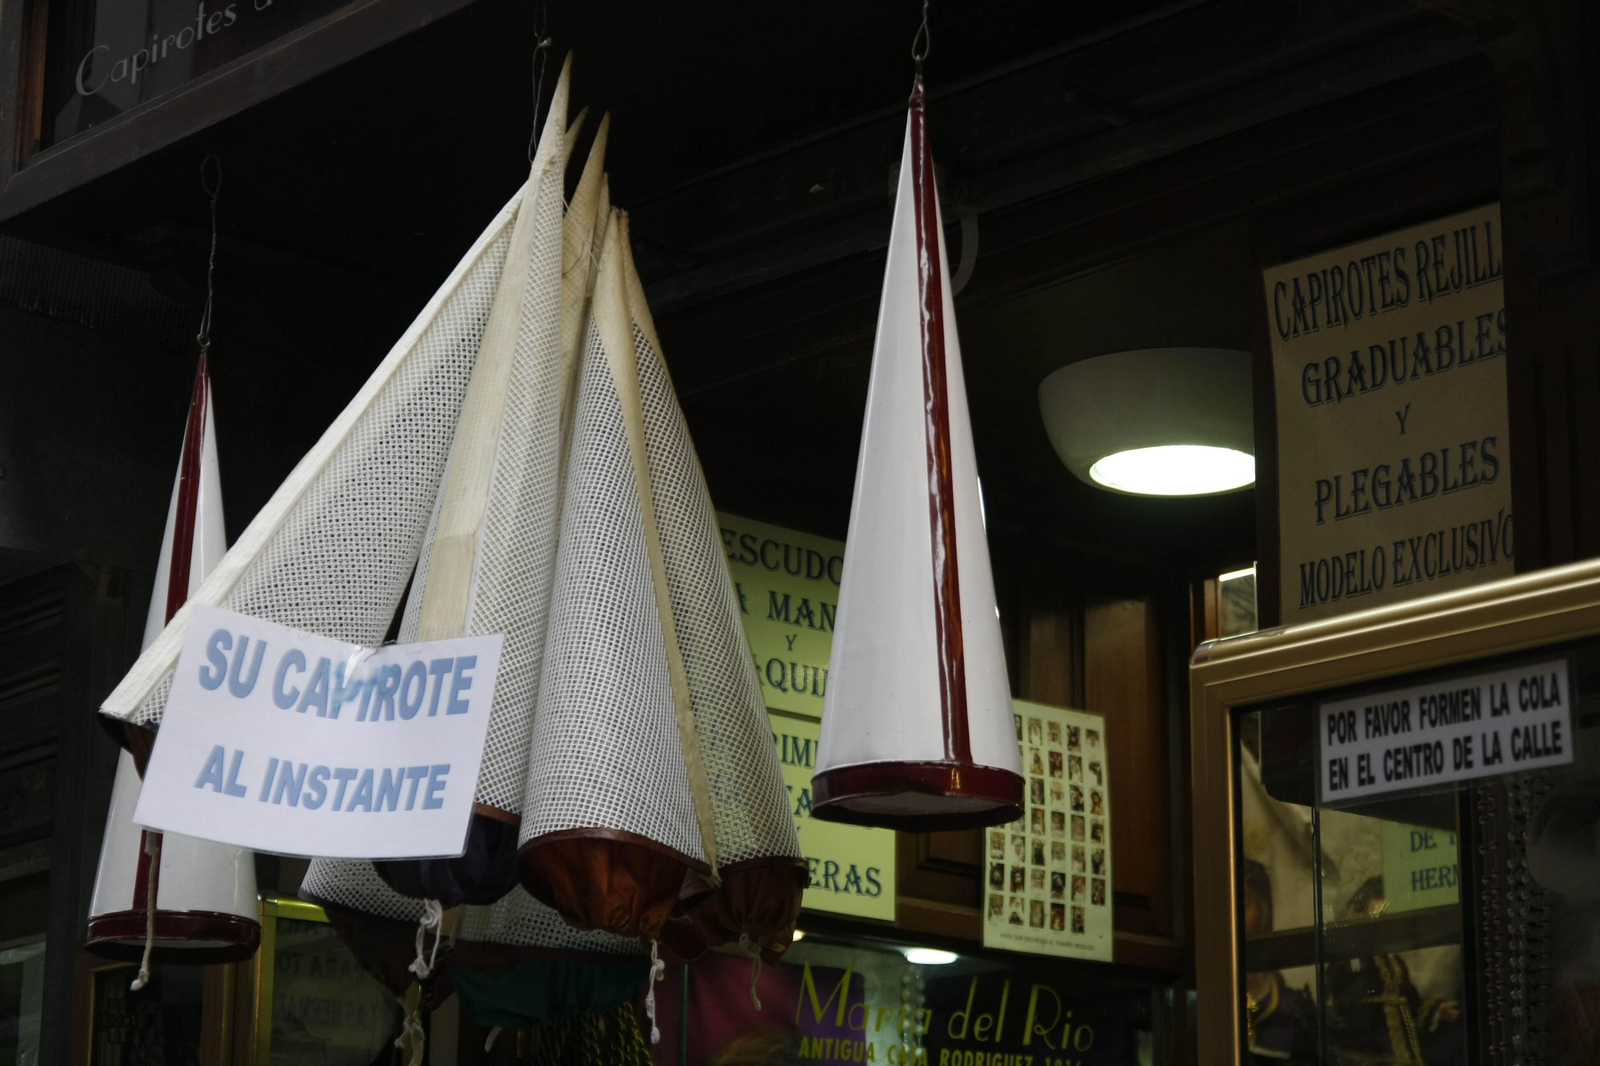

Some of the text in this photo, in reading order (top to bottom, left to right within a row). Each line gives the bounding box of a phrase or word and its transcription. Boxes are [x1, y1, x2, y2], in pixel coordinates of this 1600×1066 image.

[75, 3, 237, 96] Capirotes
[1274, 247, 1411, 342] CAPIROTES
[1395, 403, 1411, 435] Y
[1314, 436, 1499, 525] PLEGABLES
[1299, 507, 1514, 609] MODELO EXCLUSIVO
[198, 628, 477, 722] SU CAPIROTE
[785, 634, 798, 651] Y
[1328, 673, 1561, 746] POR FAVOR FORMEN LA COLA
[193, 744, 450, 812] AL INSTANTE
[1329, 721, 1562, 791] EN EL CENTRO DE LA CALLE
[798, 1035, 875, 1063] ANTIGUA
[948, 975, 1011, 1043] del
[1022, 984, 1095, 1051] Rio
